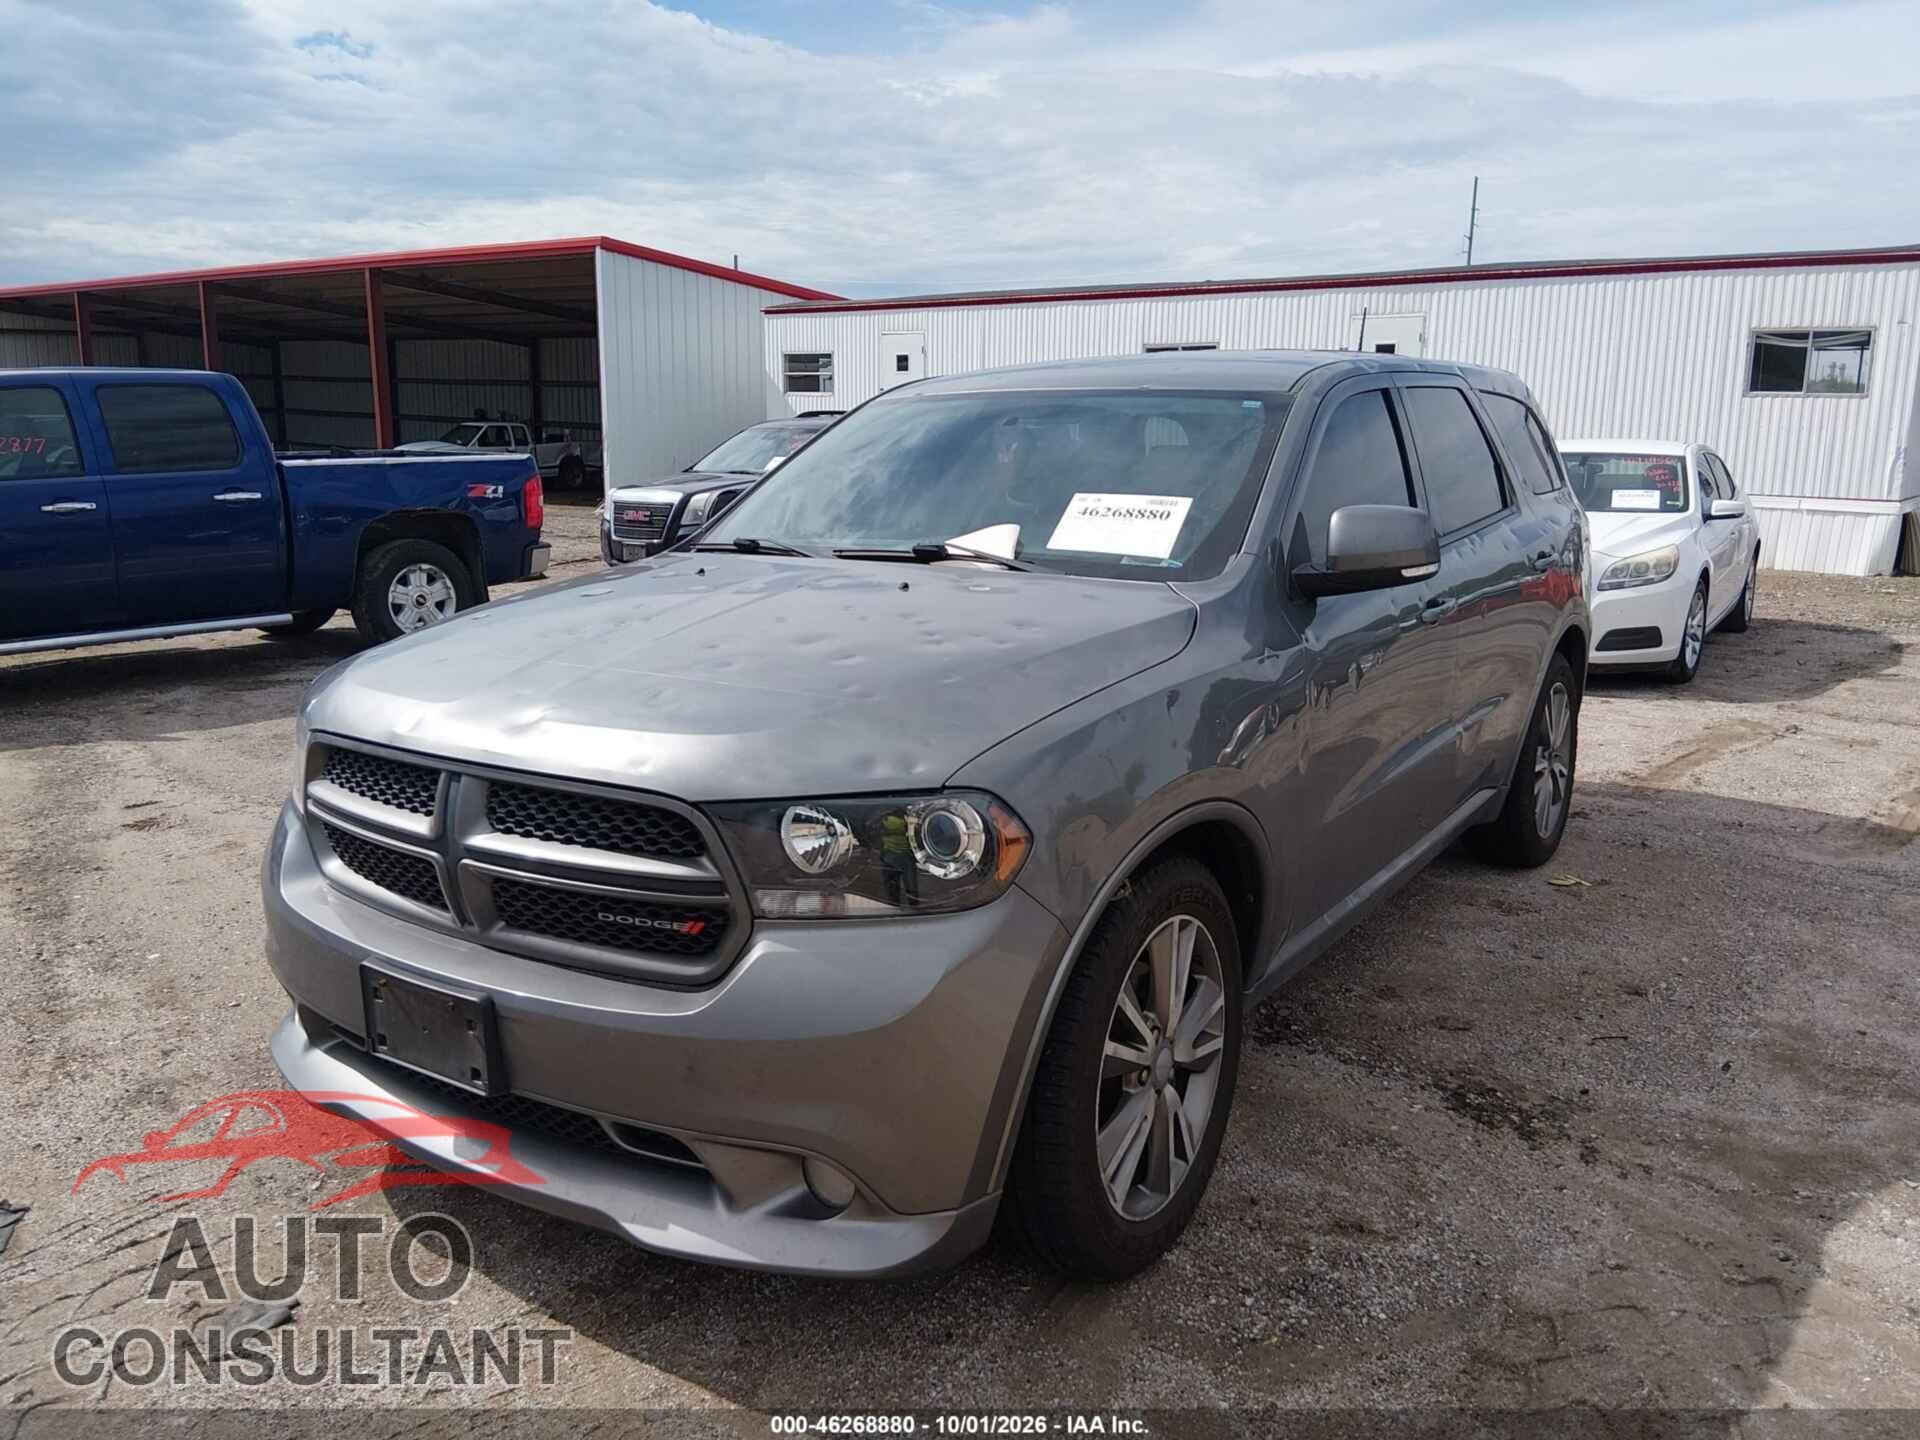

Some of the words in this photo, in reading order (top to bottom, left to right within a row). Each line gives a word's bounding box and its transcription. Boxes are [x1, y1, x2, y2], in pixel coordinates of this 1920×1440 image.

[623, 510, 651, 521] GMC
[1077, 506, 1171, 521] 46268880
[598, 912, 689, 931] DODGE
